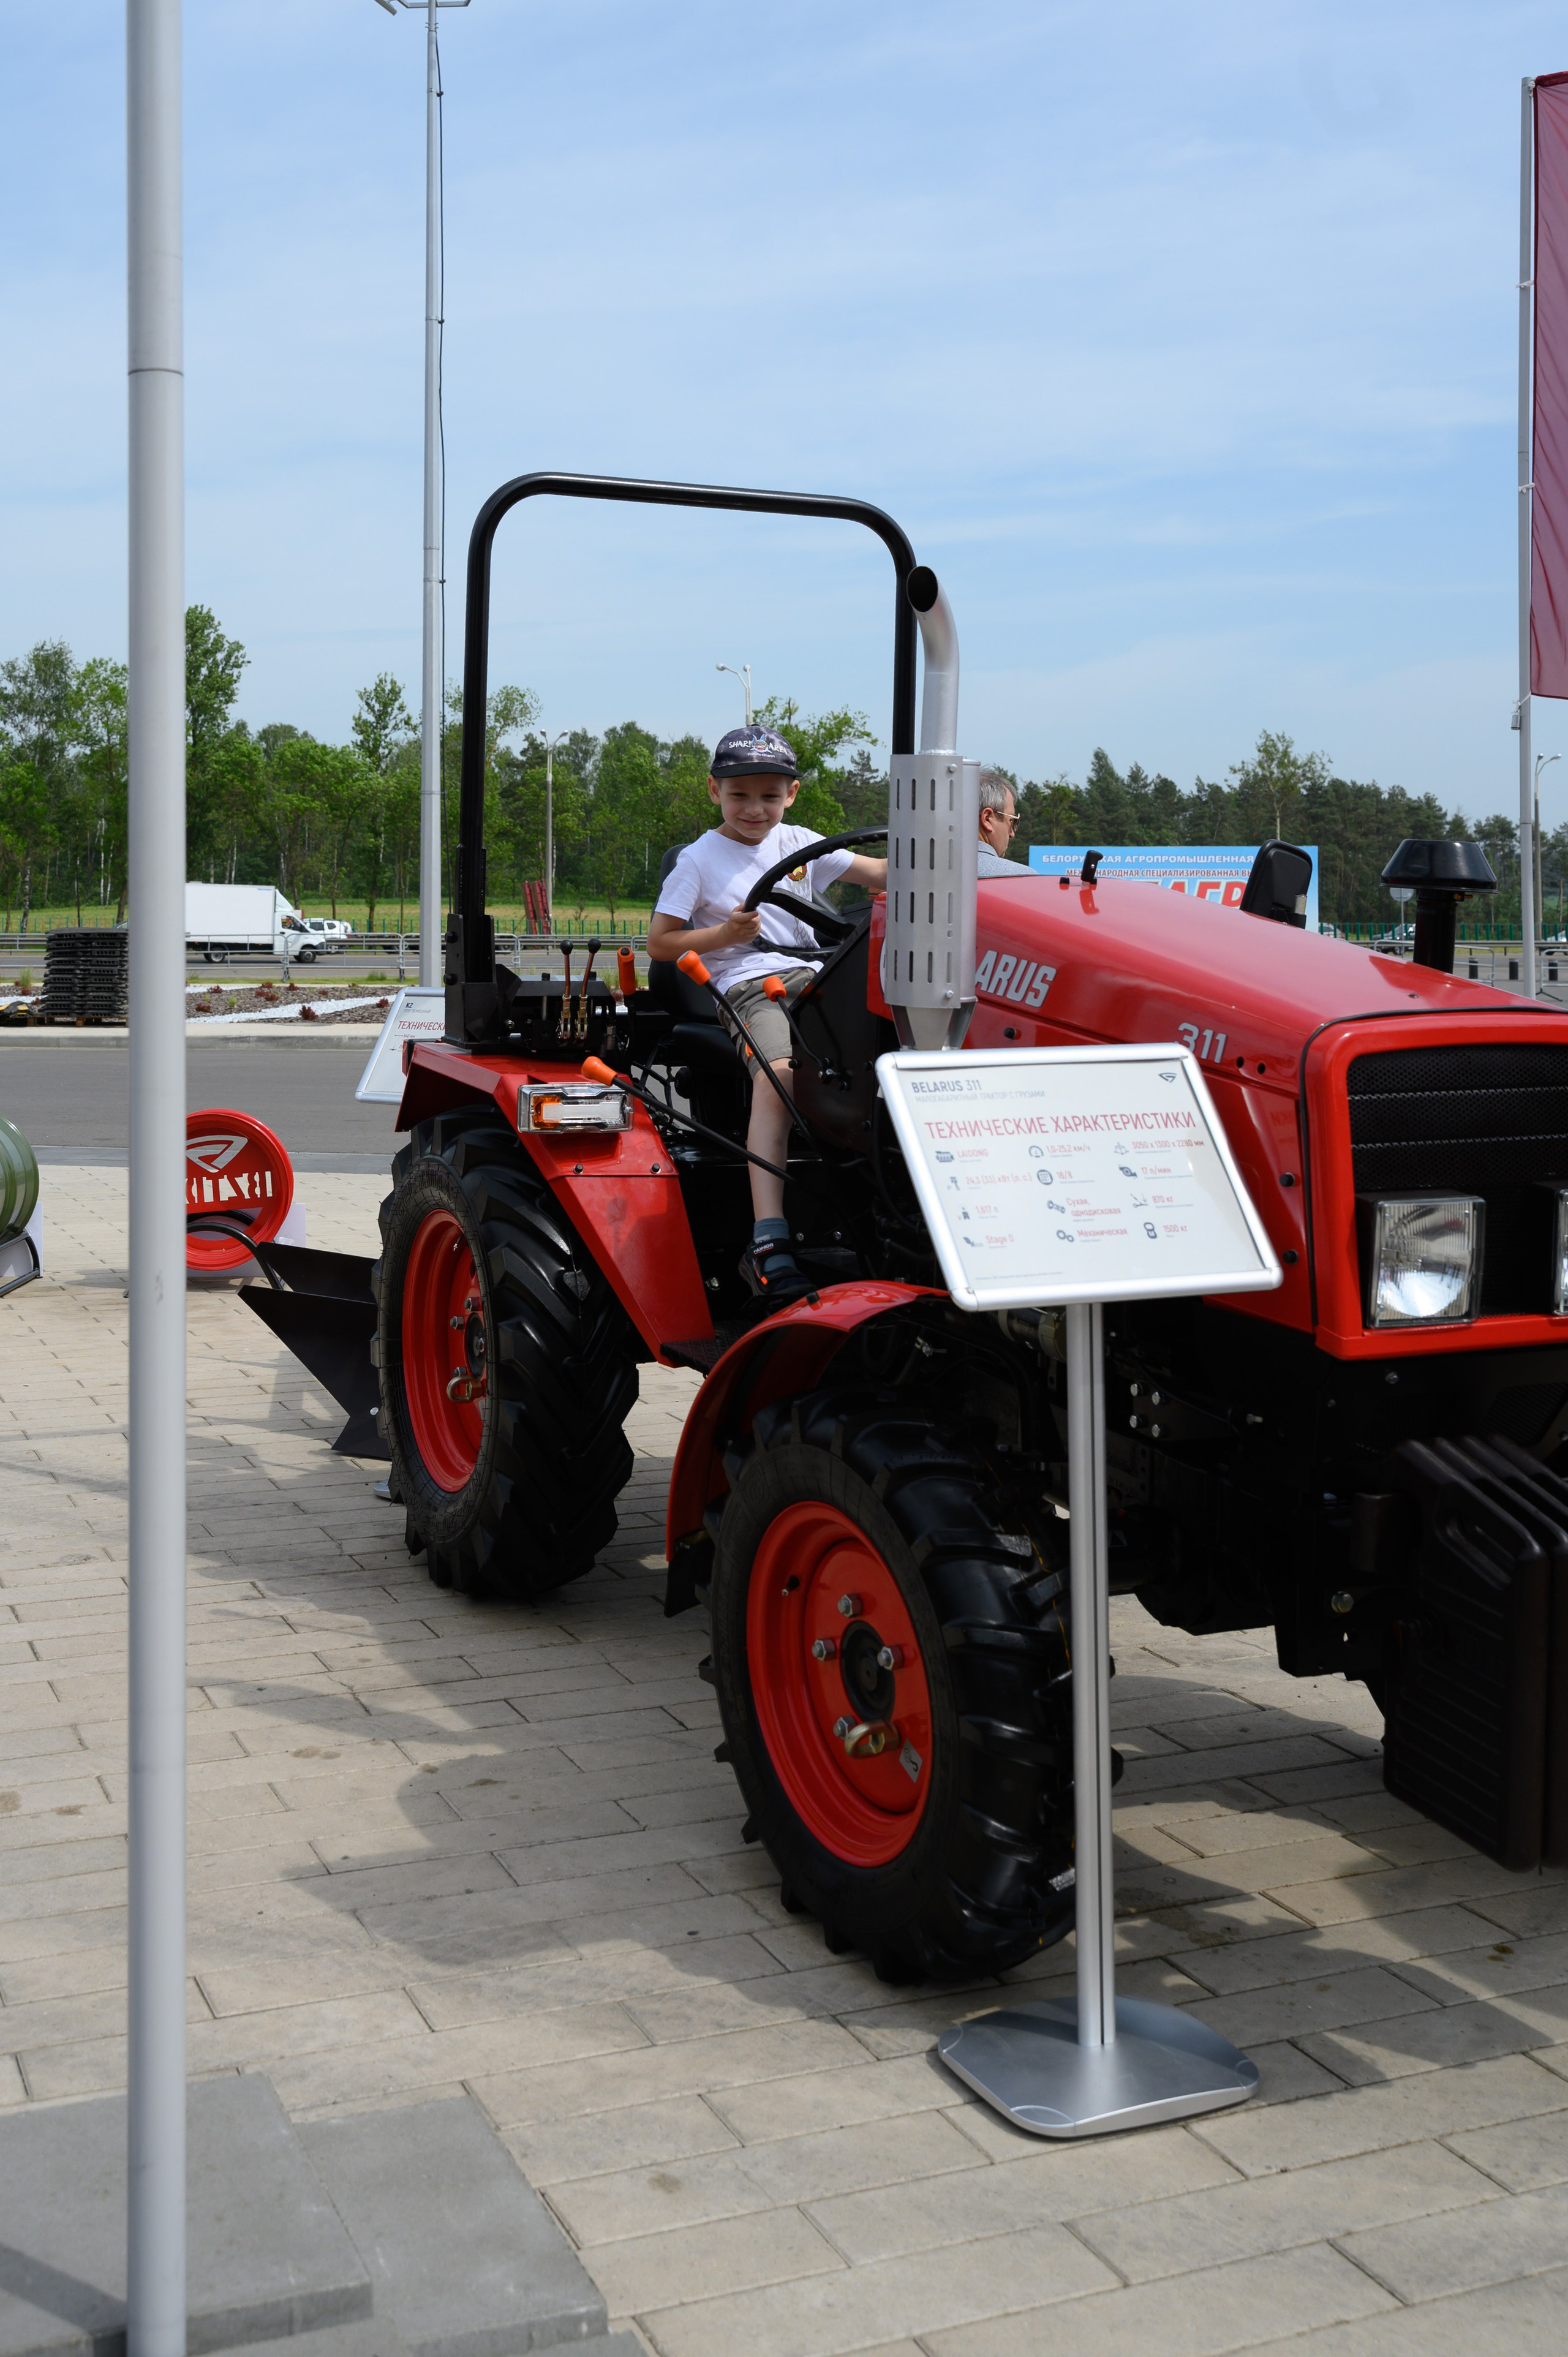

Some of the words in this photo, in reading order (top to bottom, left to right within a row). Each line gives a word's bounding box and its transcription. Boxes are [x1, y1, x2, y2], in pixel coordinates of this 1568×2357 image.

[974, 949, 1057, 1008] ARUS
[398, 1021, 445, 1030] ТЕХНИЧЕСК
[1174, 1022, 1227, 1063] 311
[911, 1080, 963, 1093] BELARUS
[965, 1079, 982, 1091] 311
[979, 1092, 1008, 1101] ТРАКТОР
[924, 1117, 1049, 1139] ТЕХНИЧЕСКИЕ
[1050, 1111, 1196, 1133] ХАРАКТЕРИСТИКИ
[1077, 1228, 1128, 1237] Механическая
